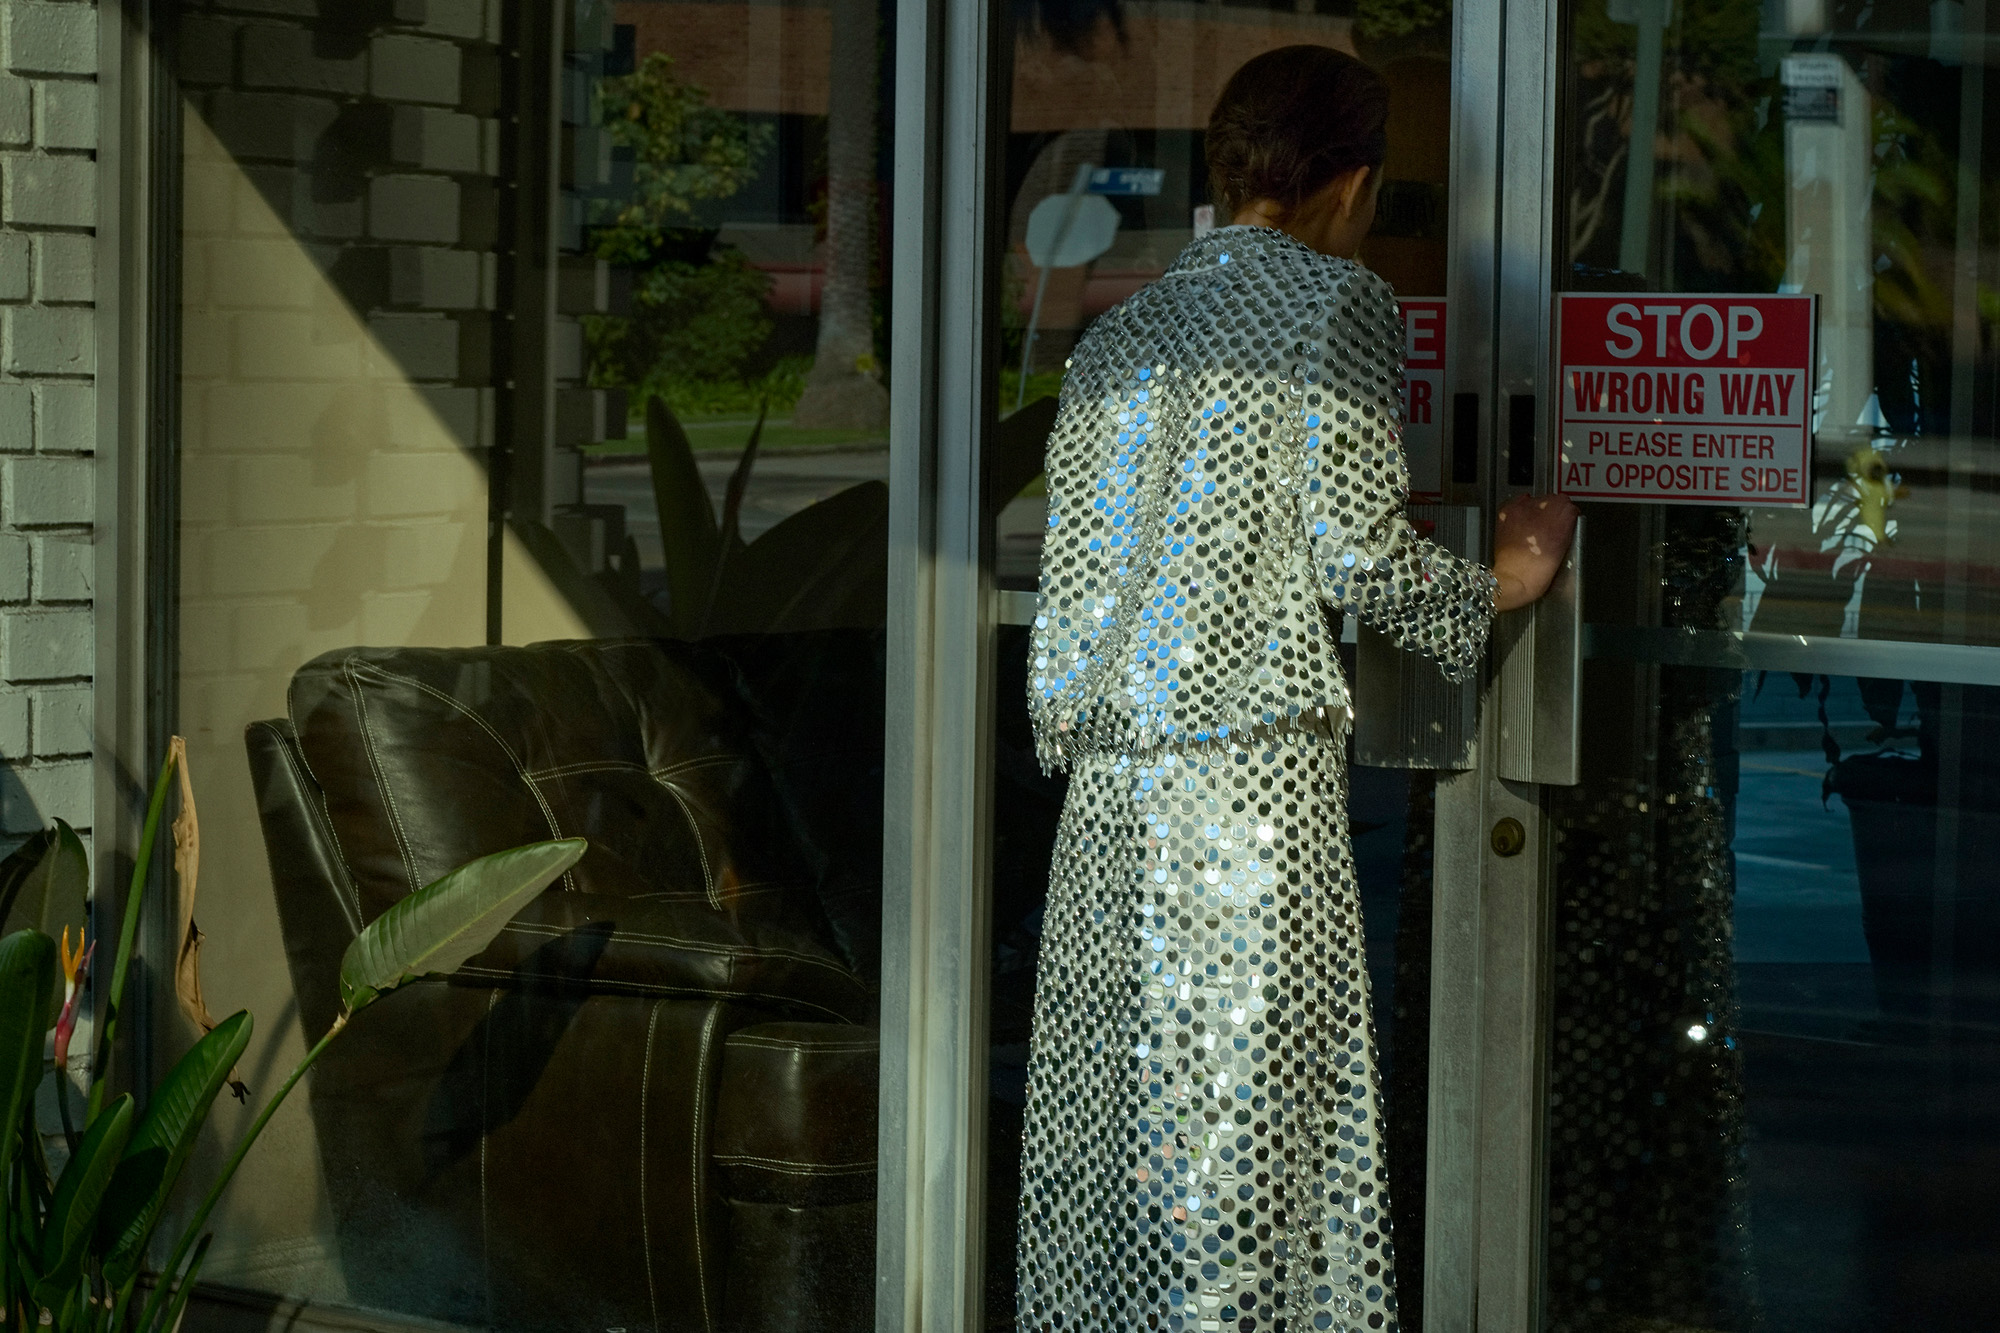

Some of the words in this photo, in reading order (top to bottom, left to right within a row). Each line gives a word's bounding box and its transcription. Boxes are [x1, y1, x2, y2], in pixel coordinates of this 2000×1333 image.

[1605, 303, 1764, 361] STOP
[1573, 371, 1705, 415] WRONG
[1719, 373, 1796, 417] WAY
[1589, 431, 1683, 458] PLEASE
[1693, 433, 1775, 460] ENTER
[1566, 462, 1596, 487] AT
[1606, 462, 1730, 491] OPPOSITE
[1740, 466, 1799, 493] SIDE
